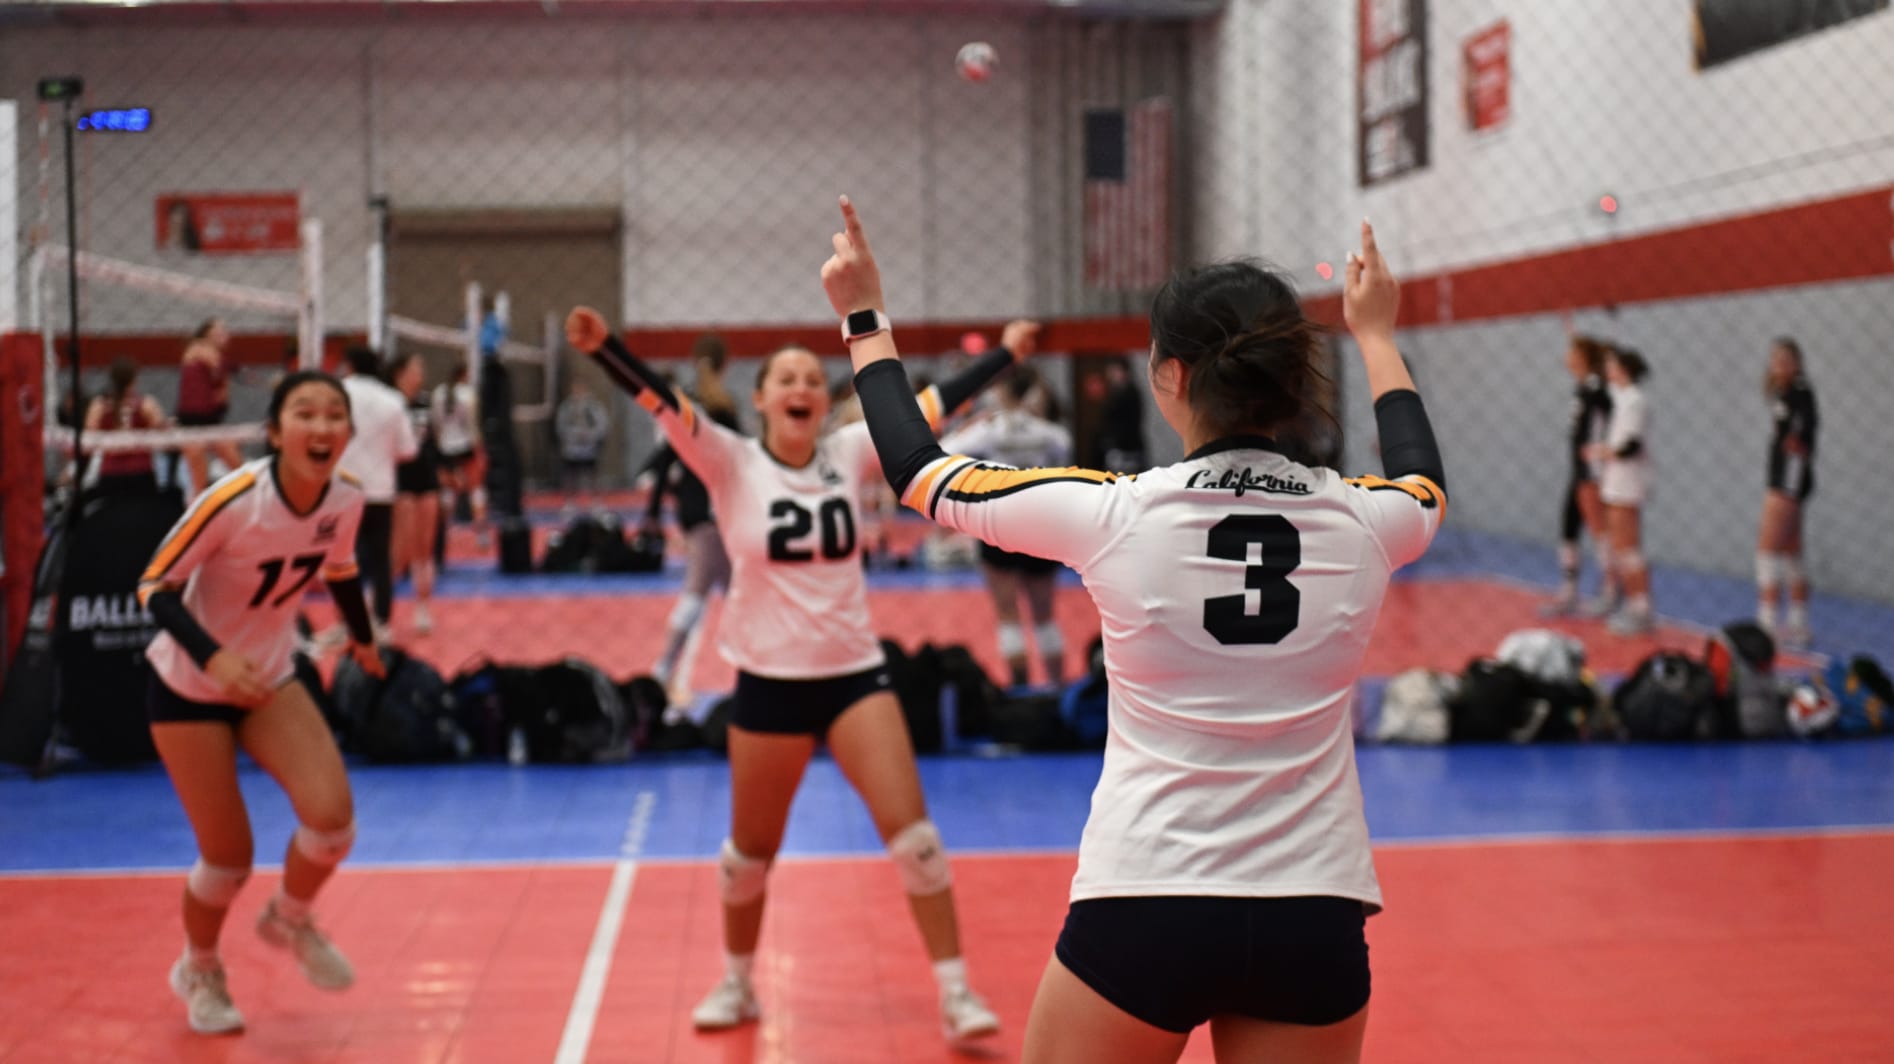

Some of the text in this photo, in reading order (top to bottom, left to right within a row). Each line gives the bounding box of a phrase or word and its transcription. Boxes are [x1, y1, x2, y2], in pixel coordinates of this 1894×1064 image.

[1184, 467, 1314, 497] California
[768, 497, 855, 561] 20
[248, 552, 325, 607] 17
[1203, 513, 1301, 645] 3
